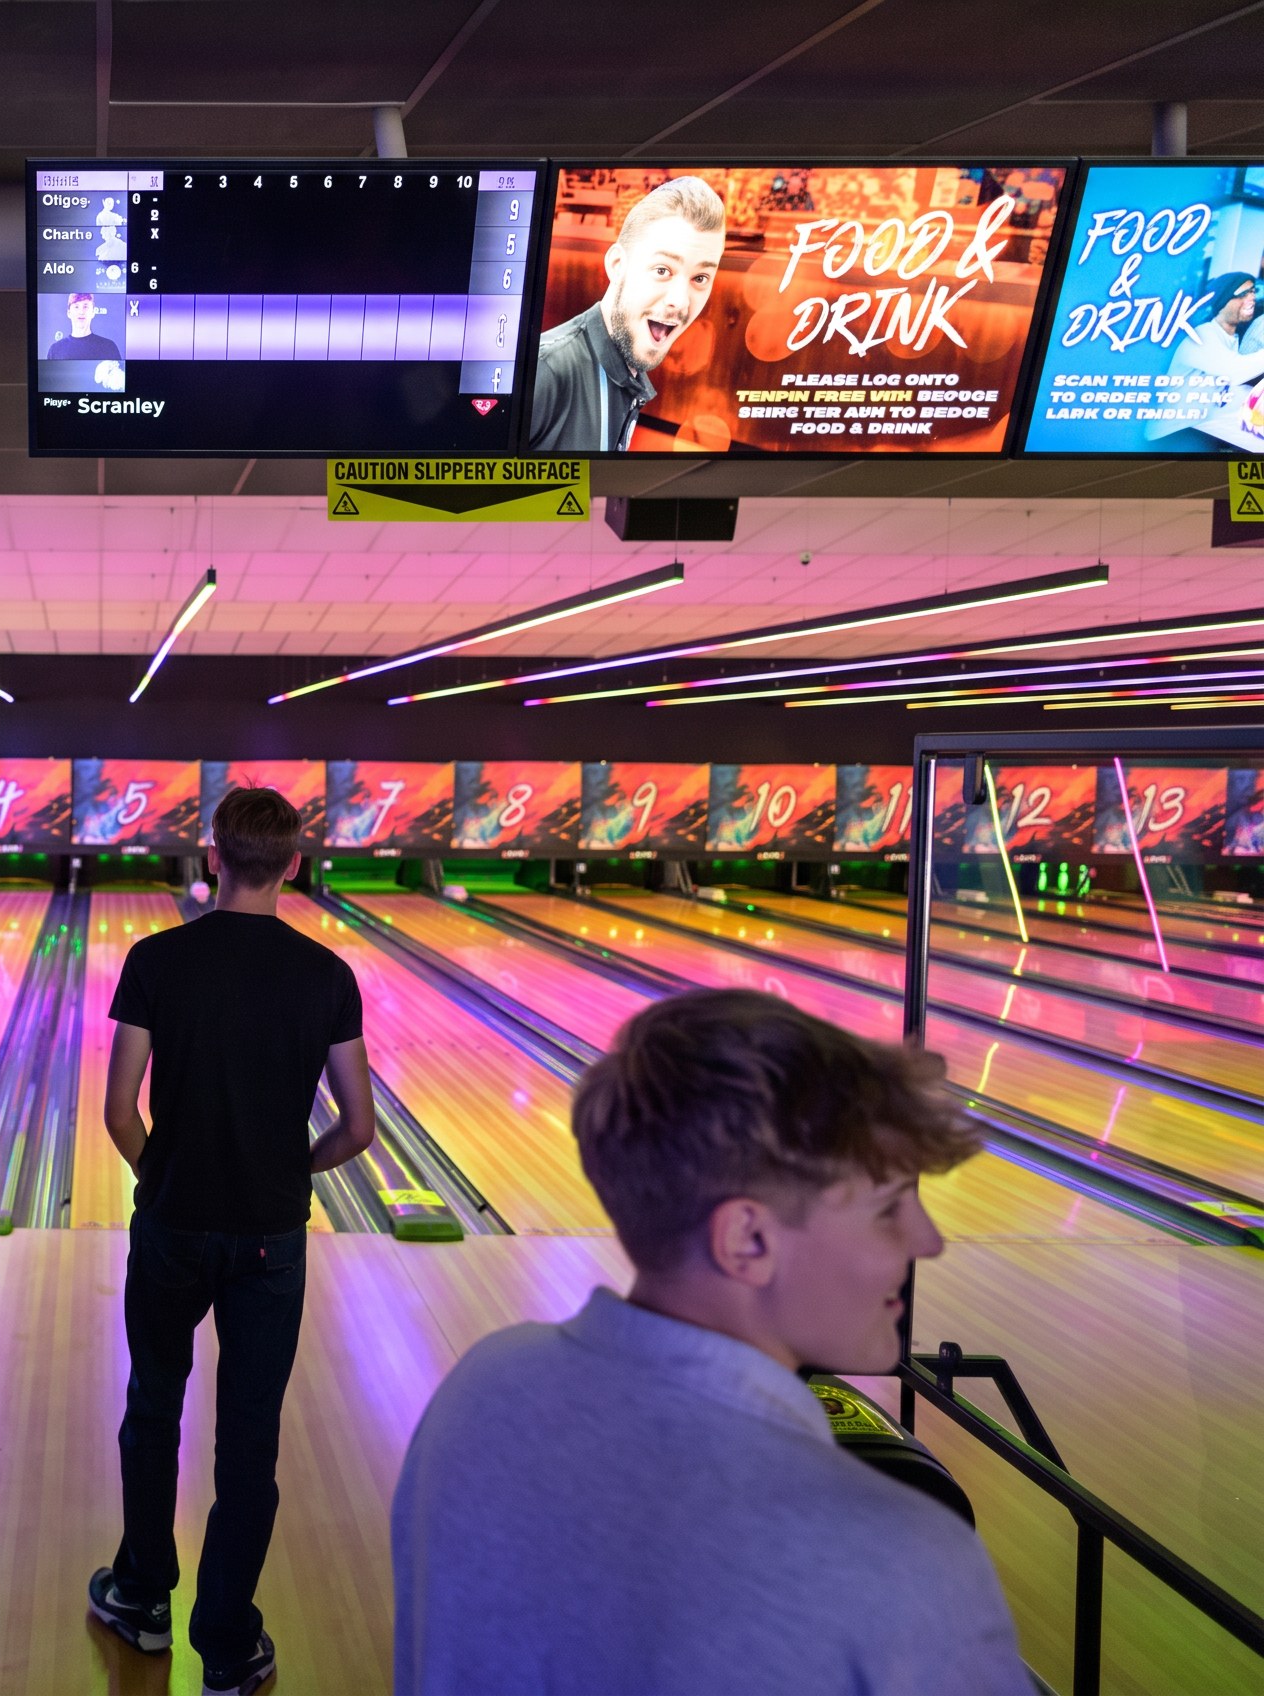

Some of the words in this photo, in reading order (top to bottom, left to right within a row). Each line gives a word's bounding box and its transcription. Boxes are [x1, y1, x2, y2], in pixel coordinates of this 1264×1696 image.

[184, 176, 193, 188] 2
[219, 176, 227, 188] 3
[254, 176, 262, 188] 4
[290, 176, 298, 188] 5
[324, 176, 332, 188] 6
[359, 176, 367, 188] 7
[394, 176, 402, 188] 8
[429, 176, 438, 188] 9
[456, 176, 472, 188] 10
[509, 199, 519, 220] 9
[506, 234, 515, 254] 5
[778, 210, 954, 293] FOOD
[955, 194, 1015, 283] &
[1078, 203, 1211, 265] FOOD
[43, 263, 74, 274] Aldo
[131, 262, 139, 273] 6
[1109, 253, 1142, 298] &
[149, 279, 157, 289] 6
[502, 268, 512, 289] 6
[786, 277, 978, 357] DRINK
[1061, 289, 1215, 353] DRINK
[781, 374, 858, 386] PLEASE
[861, 374, 902, 386] LOG
[905, 374, 959, 386] ONTO
[1053, 375, 1108, 387] SCAN
[1112, 375, 1151, 387] THE
[736, 390, 810, 402] TENPIN
[813, 390, 865, 402] FREE
[1050, 391, 1076, 403] TO
[1080, 391, 1152, 403] ORDER
[1155, 391, 1181, 403] TO
[78, 398, 165, 417] Scranley
[803, 407, 842, 419] TER
[889, 407, 916, 419] TO
[1103, 407, 1132, 419] OR
[790, 422, 845, 434] FOOD
[849, 422, 863, 434] &
[867, 422, 932, 434] DRINK
[334, 461, 409, 480] CAUTION
[414, 461, 497, 480] SLIPPERY
[502, 461, 581, 480] SURFACE
[117, 782, 154, 825] 5
[370, 781, 405, 836] 7
[499, 783, 532, 827] 8
[633, 781, 658, 832] 9
[750, 781, 796, 831] 10
[1005, 783, 1054, 836] 12
[1136, 783, 1185, 834] 13
